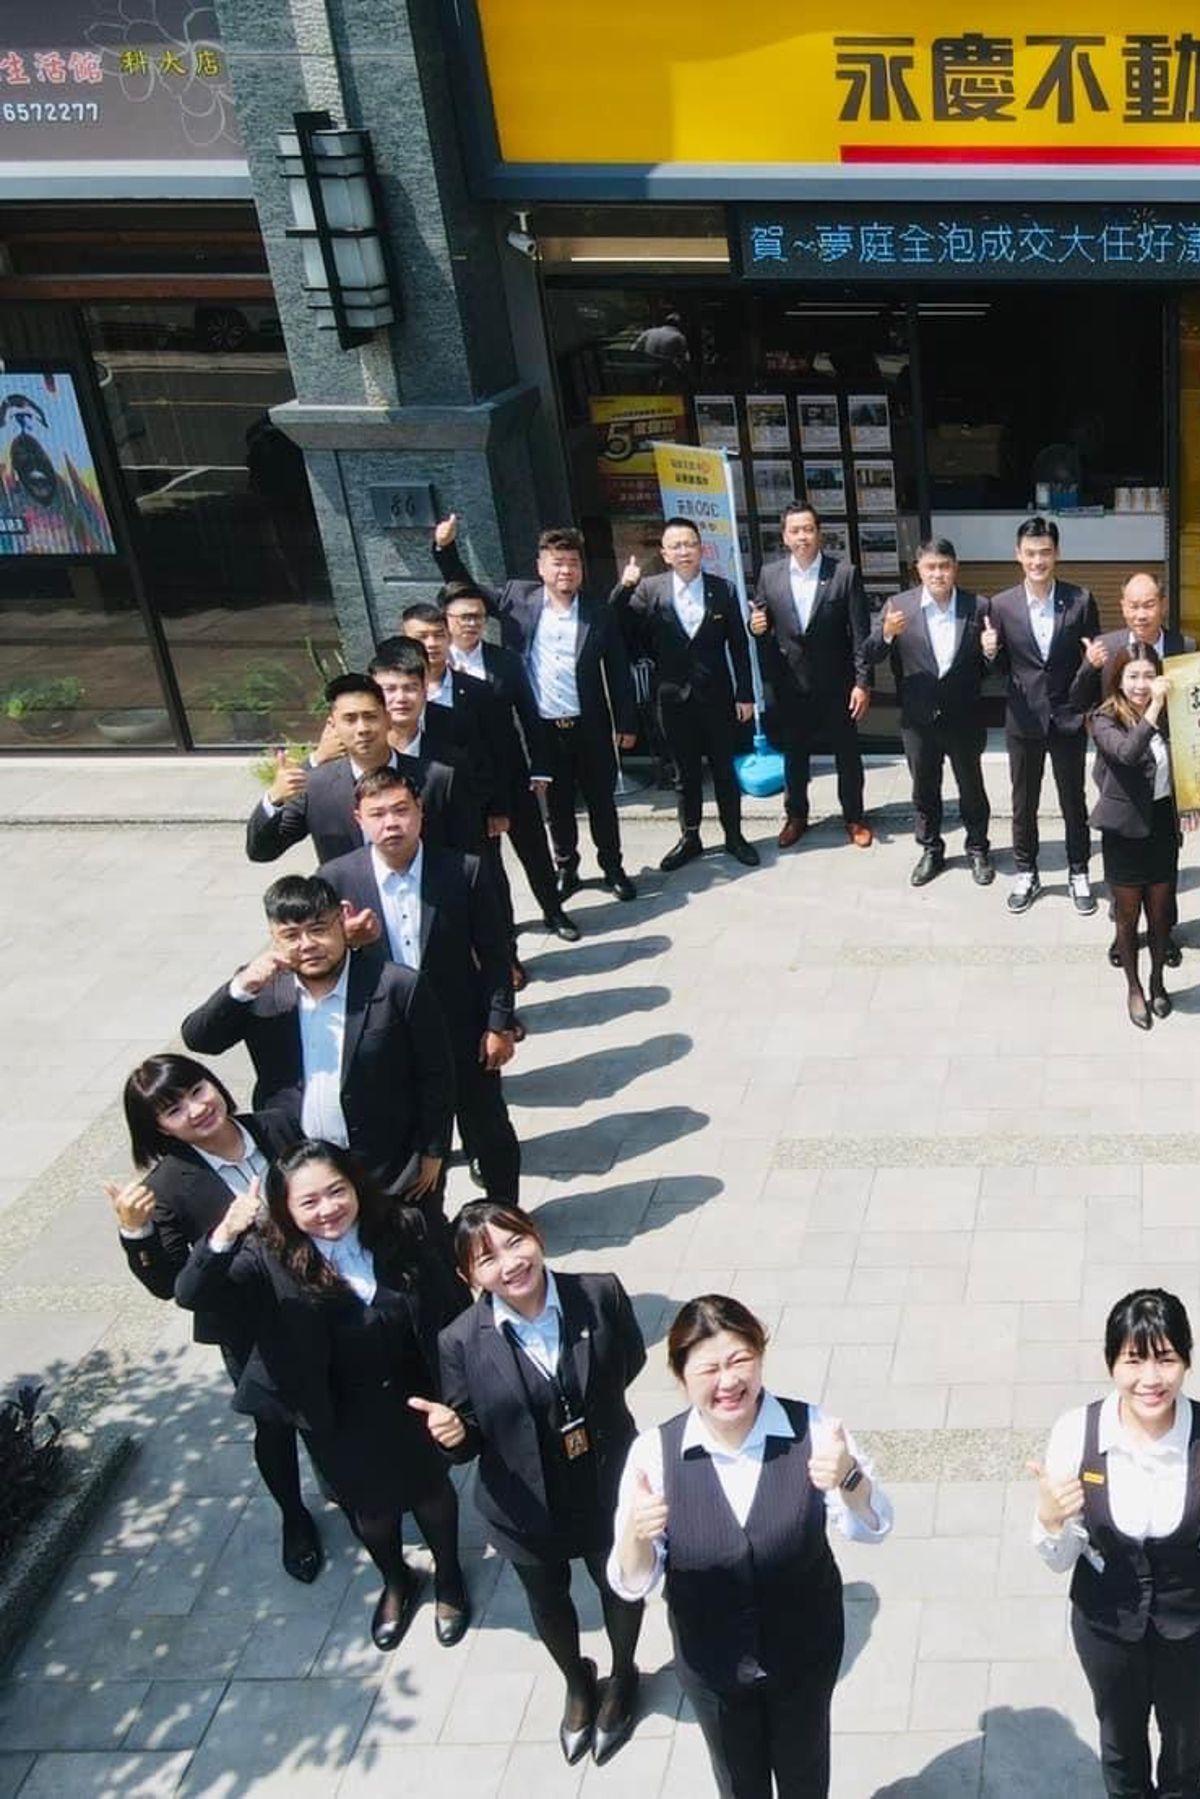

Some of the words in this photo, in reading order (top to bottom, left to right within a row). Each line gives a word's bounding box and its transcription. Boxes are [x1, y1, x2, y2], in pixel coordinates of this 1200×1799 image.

[0, 51, 103, 84] 生活館
[2, 103, 99, 121] 6572277
